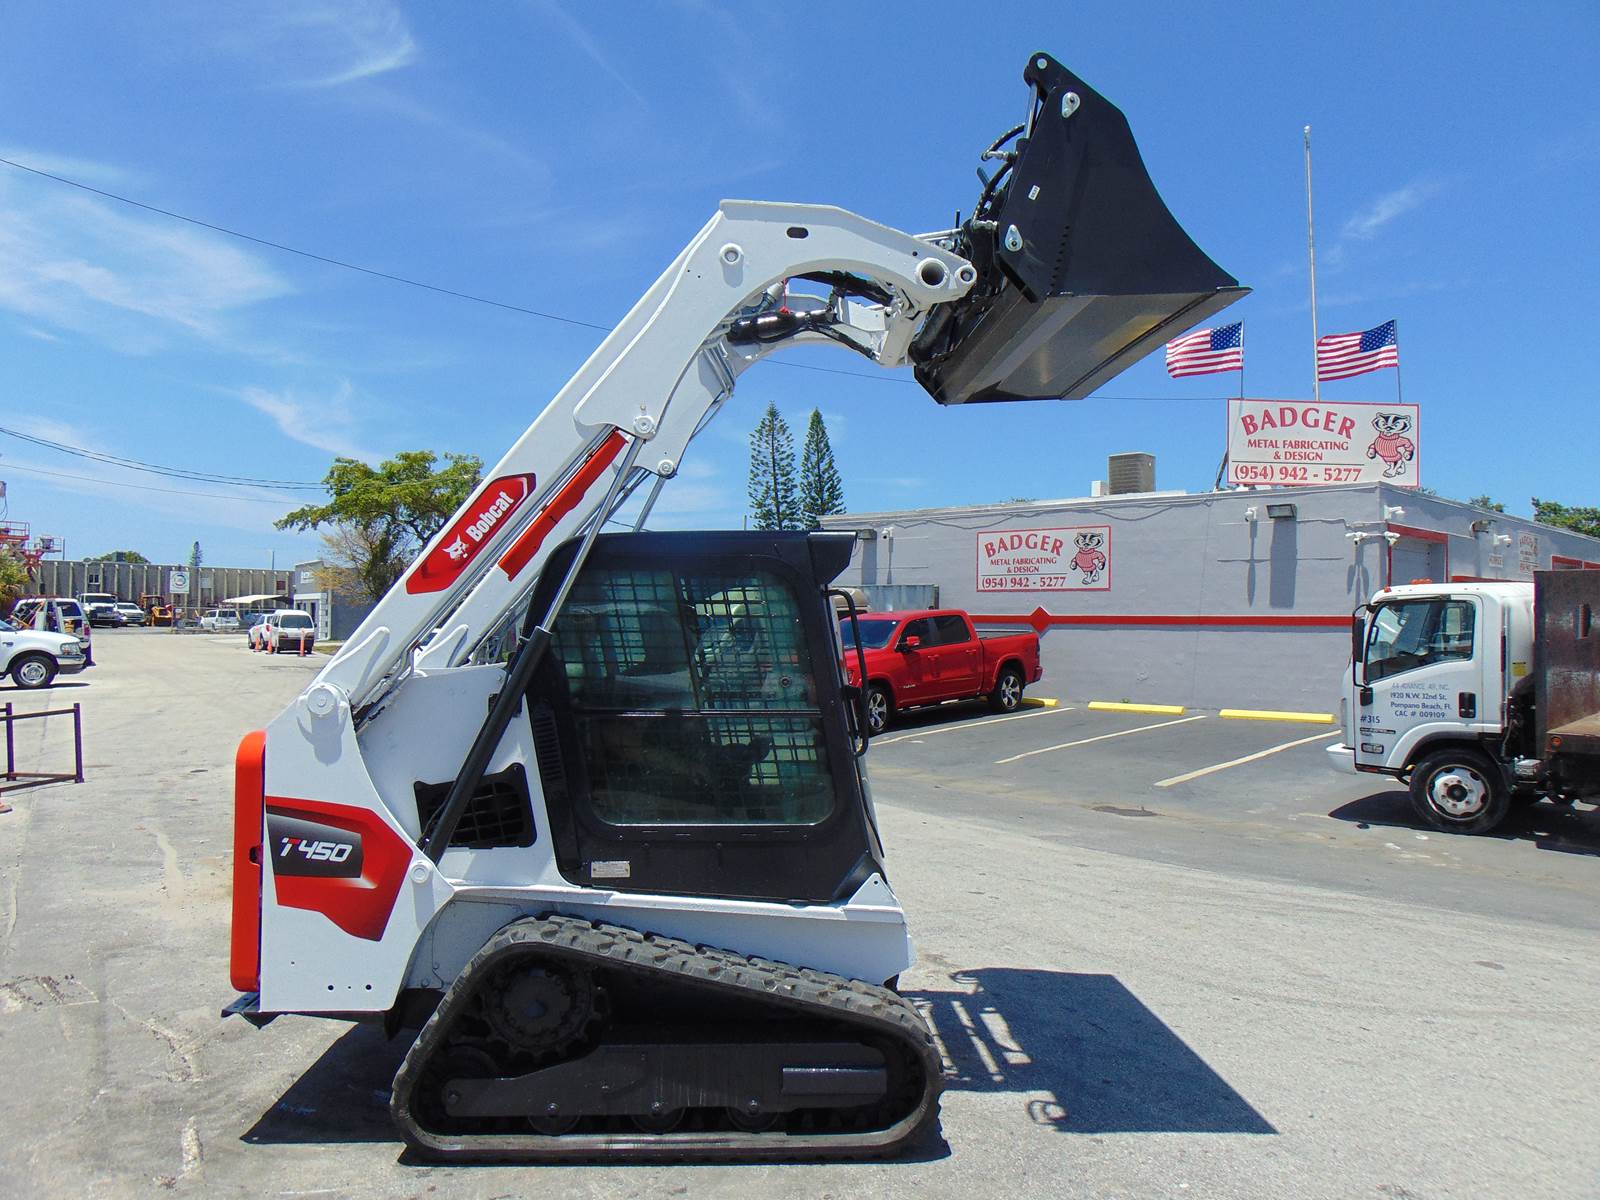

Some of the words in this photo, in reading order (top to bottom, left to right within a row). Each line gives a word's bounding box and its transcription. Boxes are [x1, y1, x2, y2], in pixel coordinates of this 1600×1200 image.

[1241, 406, 1356, 440] BADGER
[1247, 439, 1280, 449] METAL
[1283, 440, 1349, 451] FABRICATING
[1273, 451, 1281, 460] &
[1284, 451, 1323, 461] DESIGN
[1234, 465, 1274, 480] (954)
[1279, 466, 1308, 481] 942
[1324, 468, 1362, 482] 5277
[465, 491, 514, 542] Bobcat
[984, 533, 1064, 558] BADGER
[990, 558, 1010, 566] METAL
[1012, 557, 1057, 566] FABRICATING
[982, 577, 1007, 589] (954)
[1010, 577, 1029, 588] 942
[1040, 576, 1066, 588] 5277
[1390, 701, 1420, 709] Pompano
[1360, 715, 1381, 724] #315
[280, 837, 353, 862] T450
